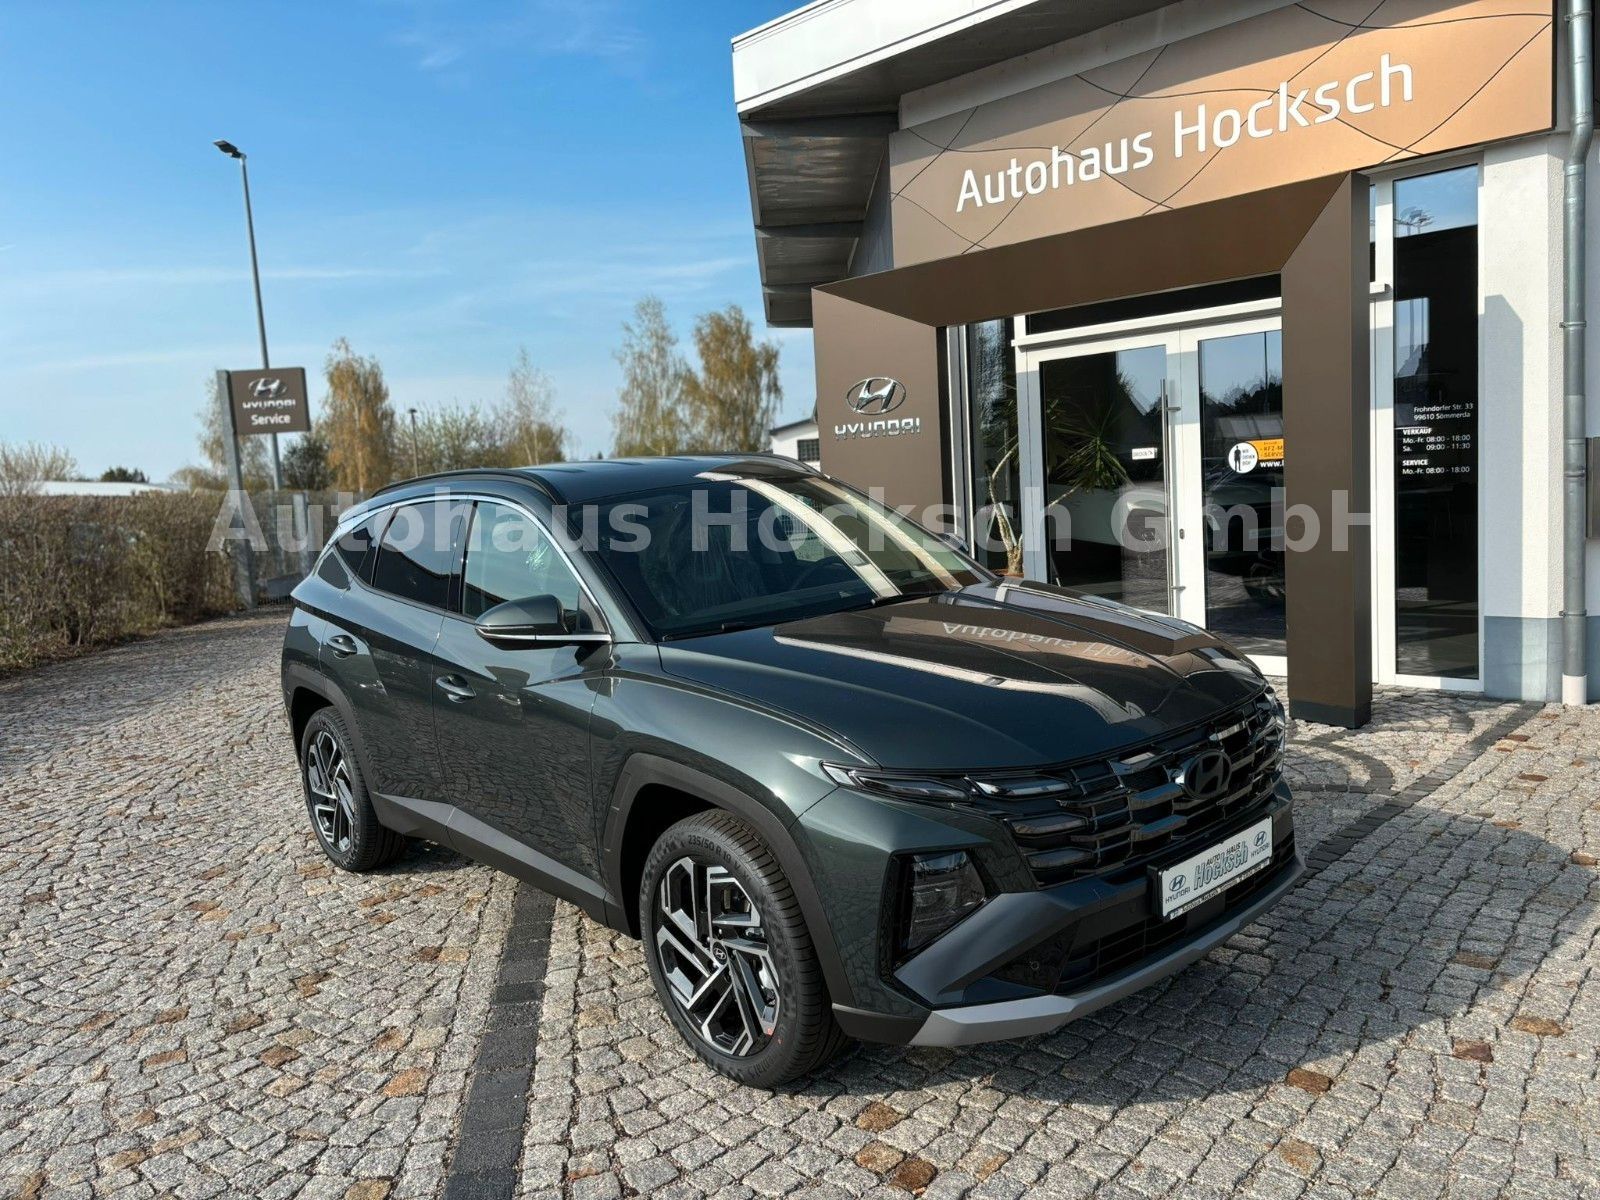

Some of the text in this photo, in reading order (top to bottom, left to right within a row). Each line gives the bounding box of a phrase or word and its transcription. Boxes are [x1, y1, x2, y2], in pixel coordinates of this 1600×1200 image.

[955, 53, 1414, 212] Autohaus Hocksch
[251, 412, 291, 426] Service
[1452, 434, 1471, 442] 18:00
[688, 835, 714, 851] 235/50
[1193, 841, 1249, 891] Hocksch
[1165, 886, 1191, 904] HYUNDAI
